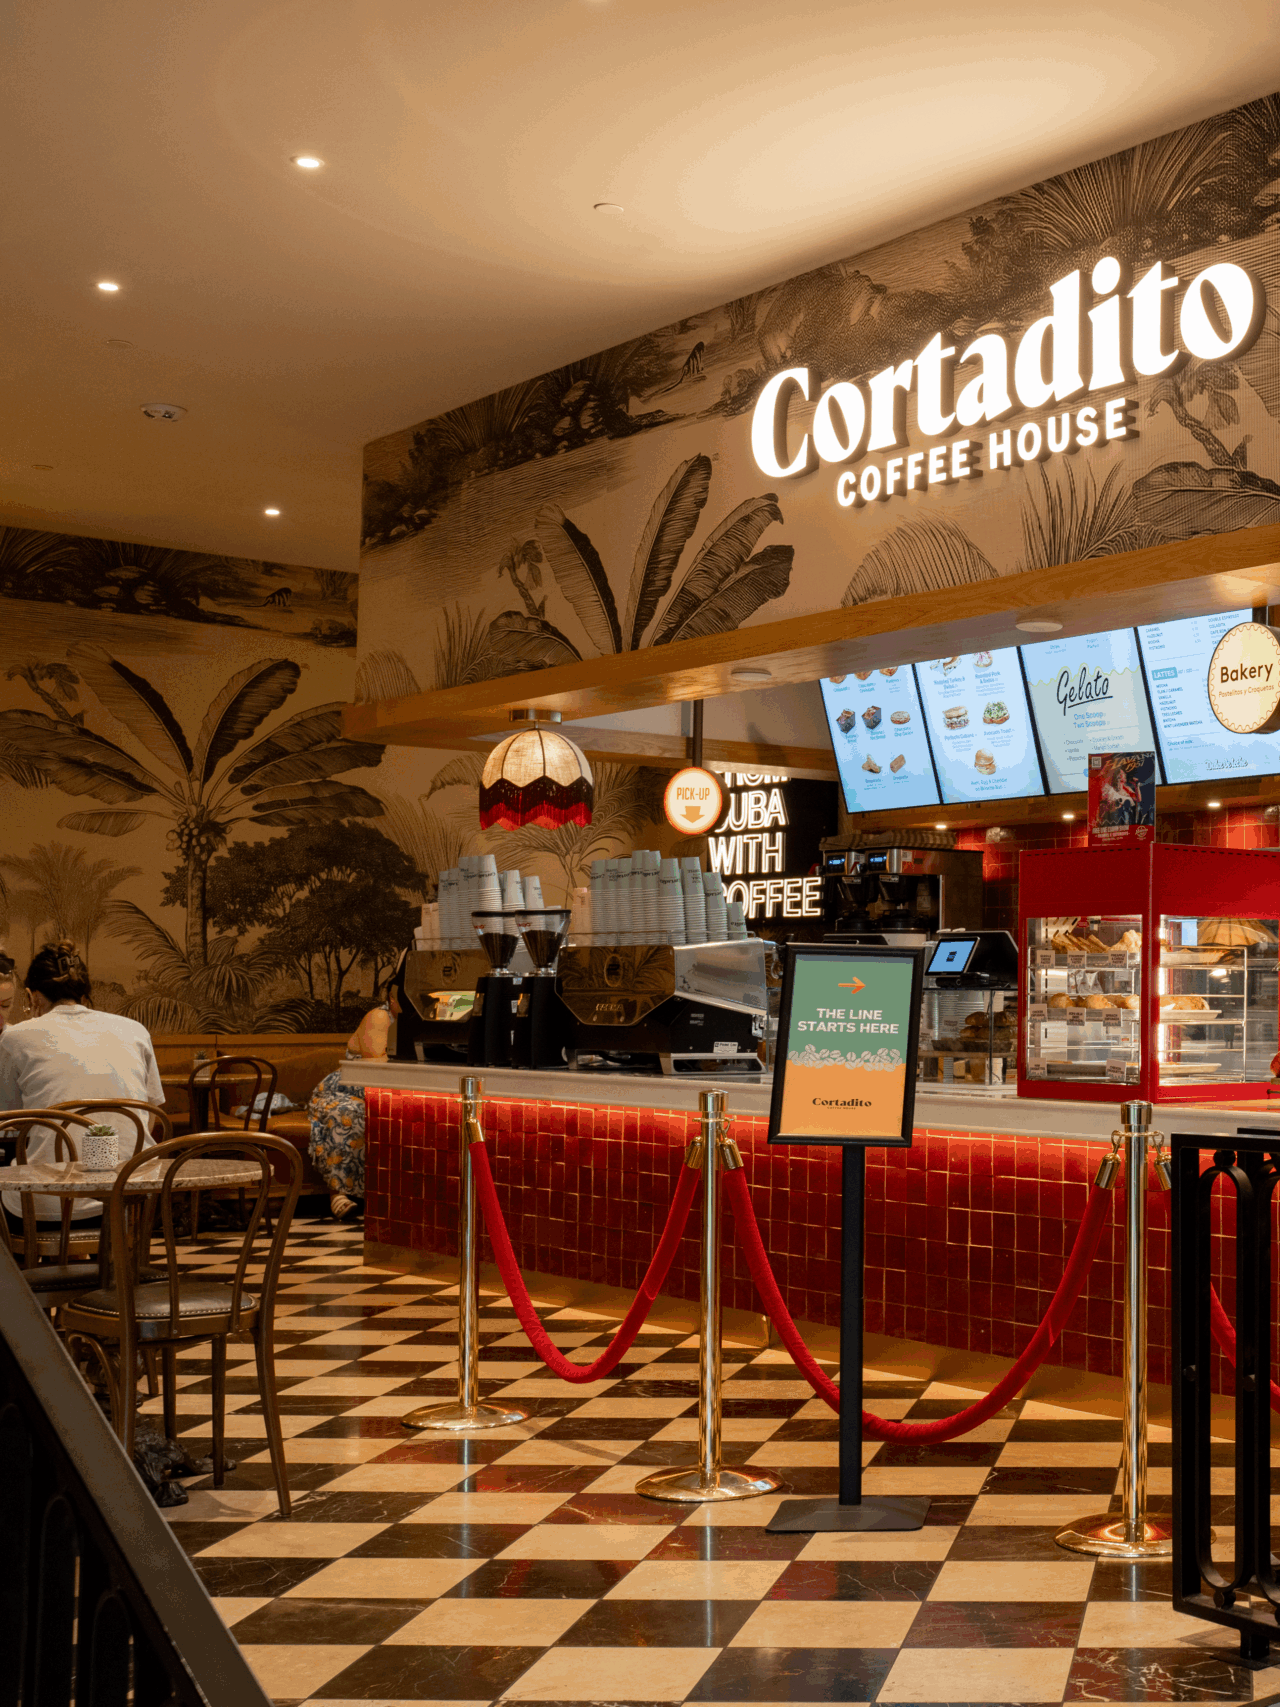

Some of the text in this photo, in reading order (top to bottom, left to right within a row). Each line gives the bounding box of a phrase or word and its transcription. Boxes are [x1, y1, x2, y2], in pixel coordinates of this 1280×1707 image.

[750, 256, 1255, 478] Cortadito
[836, 397, 1127, 507] COFFEE HOUSE
[1153, 669, 1176, 679] LATTES
[1220, 663, 1274, 683] Bakery
[1056, 666, 1109, 717] Gelato
[1085, 711, 1104, 719] Scoop
[676, 787, 710, 801] PICK-UP
[714, 788, 786, 833] UBA
[708, 832, 783, 876] WITH
[816, 1008, 883, 1020] THE LINE
[797, 1021, 899, 1034] STARTS HERE
[812, 1097, 872, 1108] Cortadito
